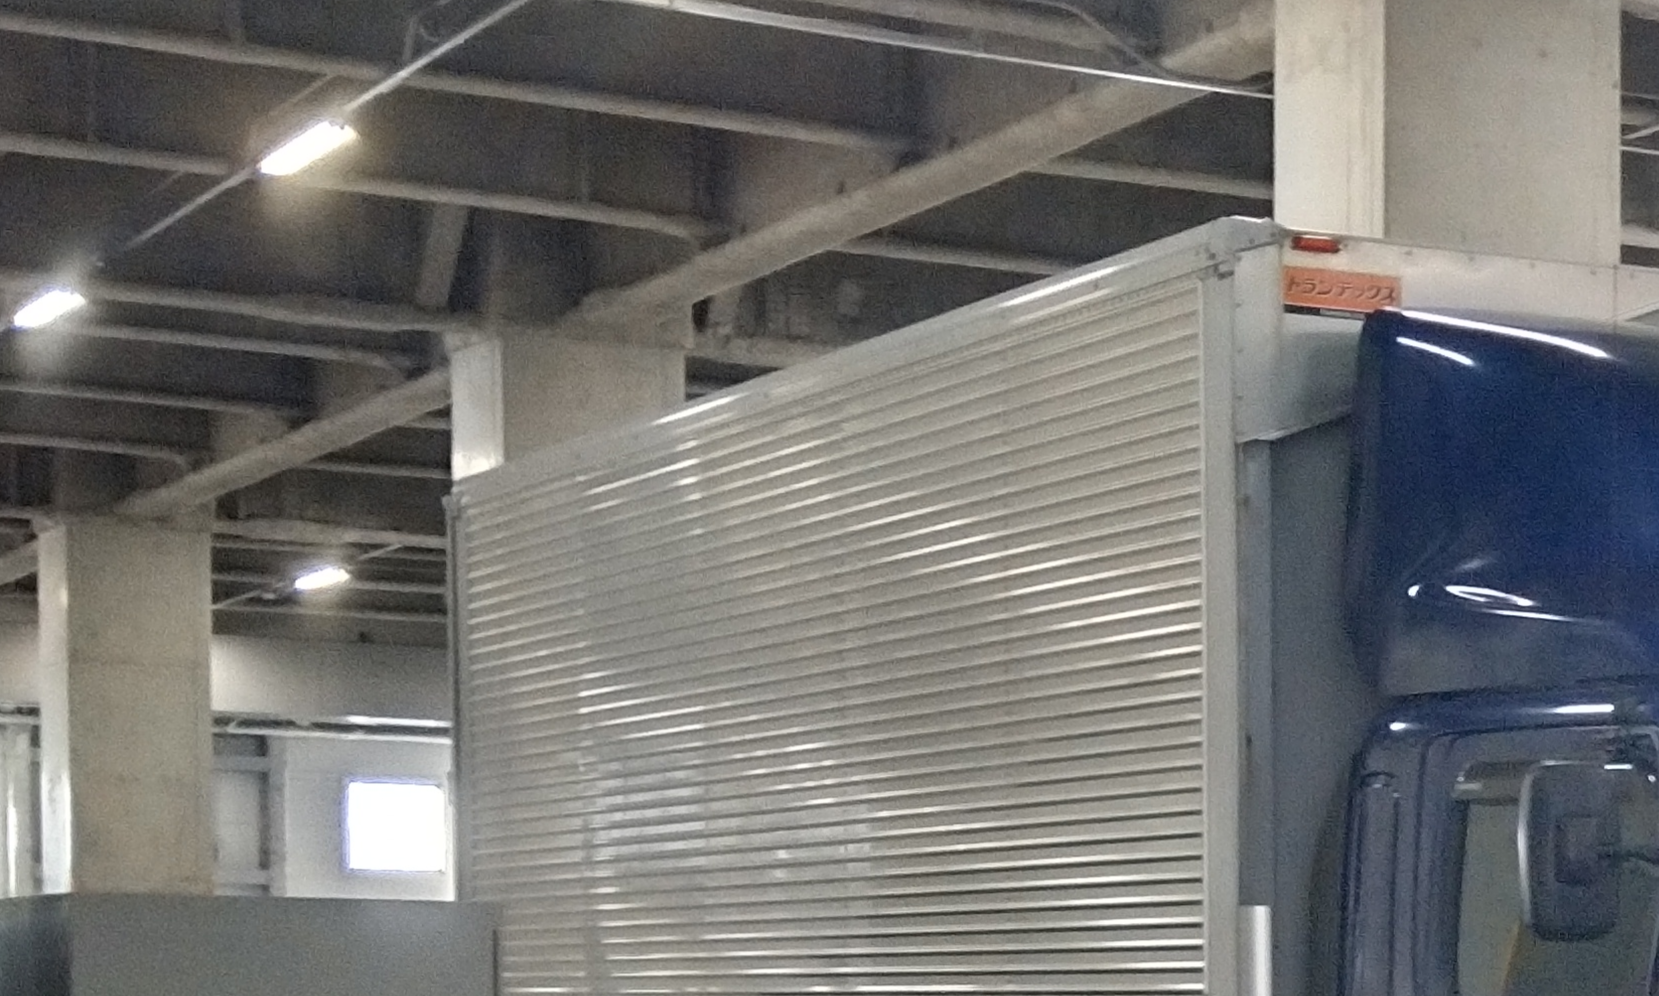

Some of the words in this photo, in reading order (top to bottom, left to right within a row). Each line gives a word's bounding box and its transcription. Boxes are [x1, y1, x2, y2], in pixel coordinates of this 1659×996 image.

[1288, 276, 1396, 304] トランテックス
